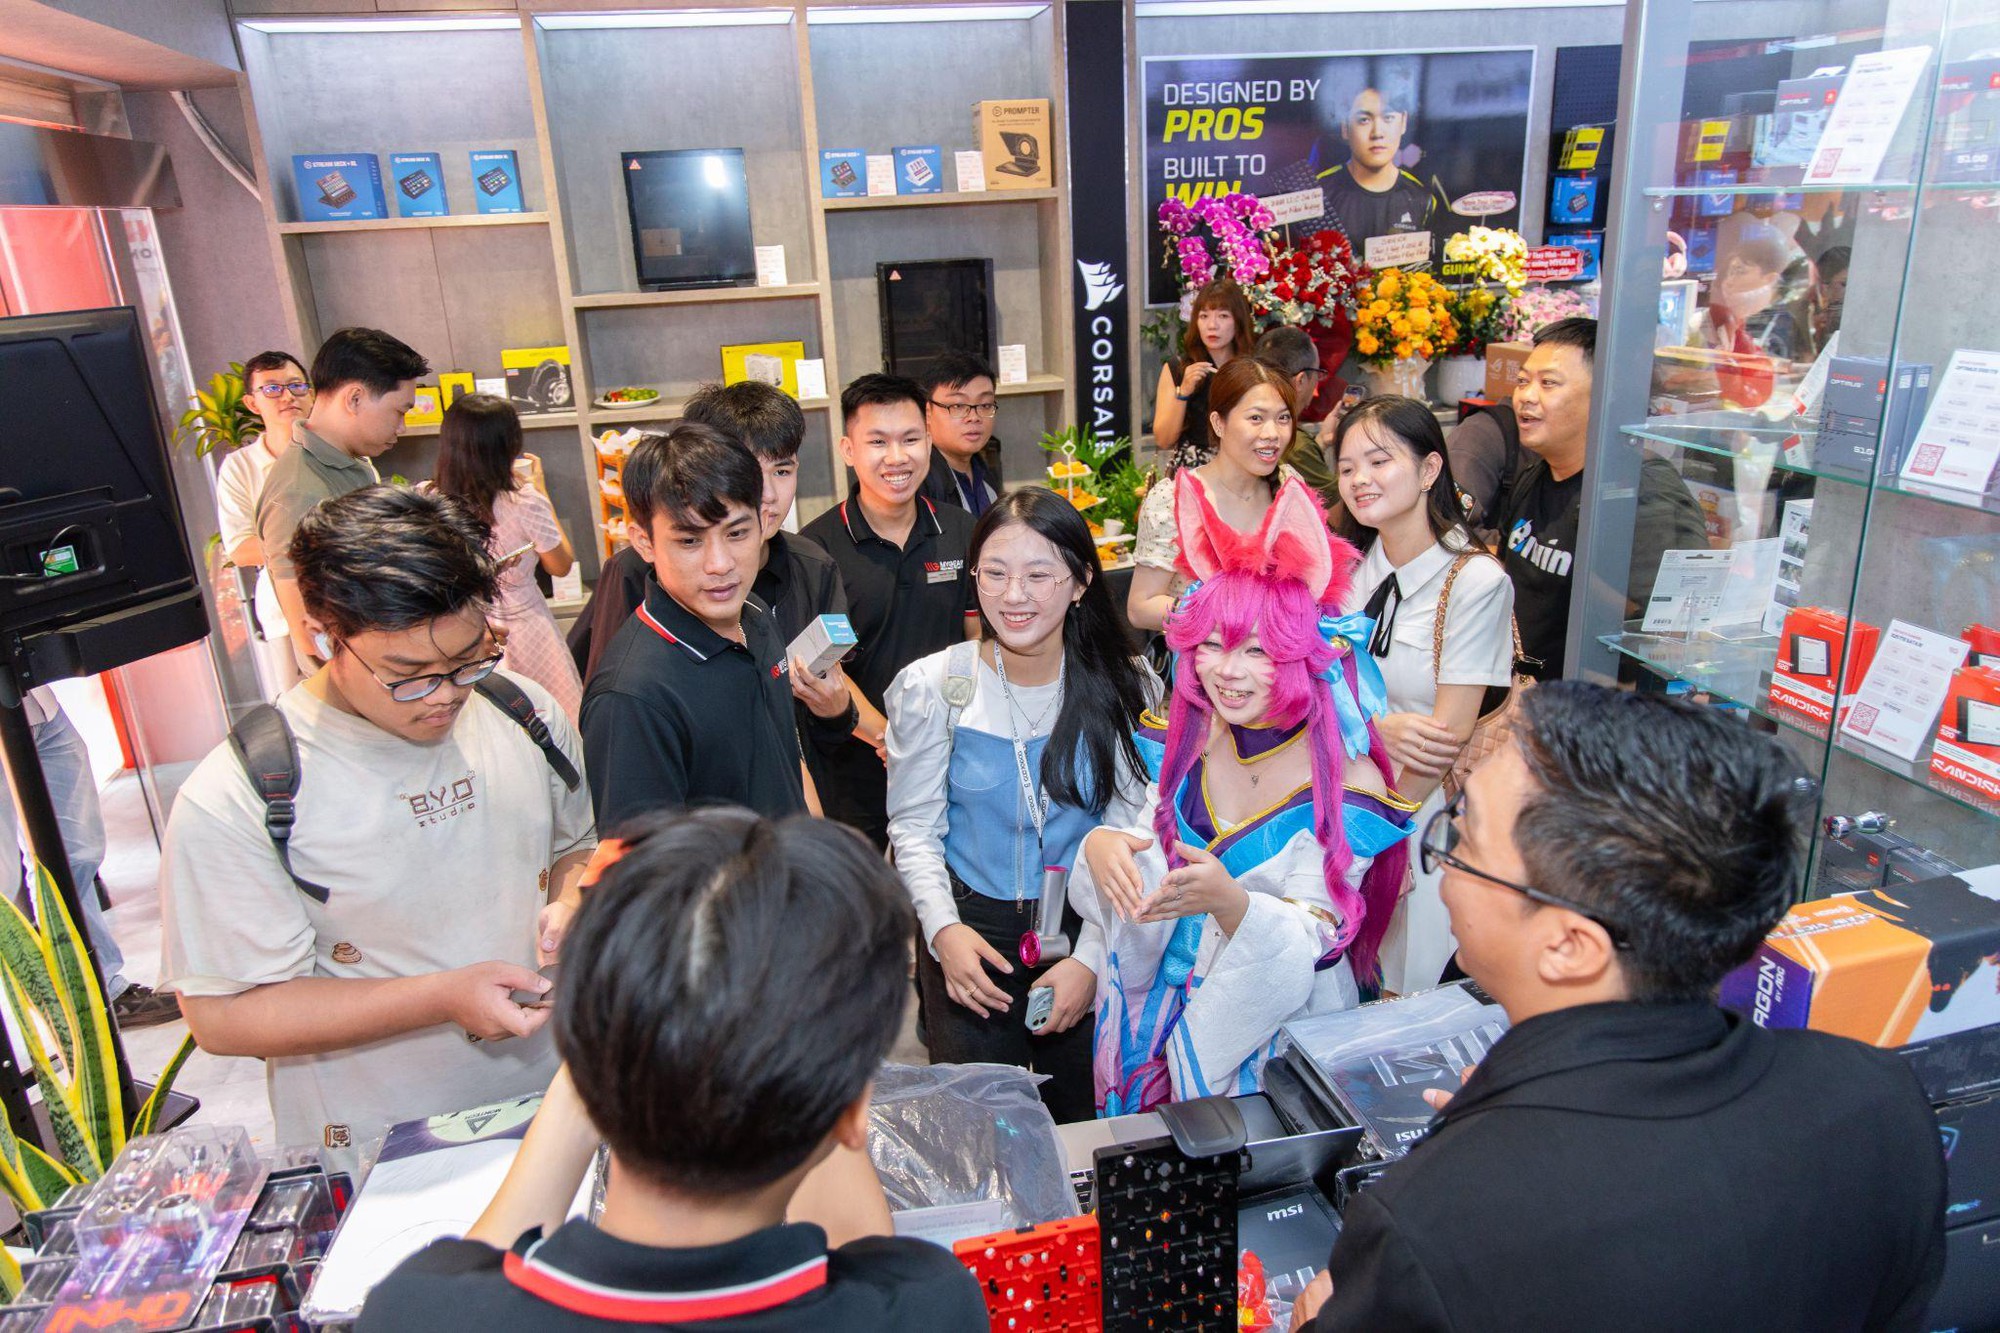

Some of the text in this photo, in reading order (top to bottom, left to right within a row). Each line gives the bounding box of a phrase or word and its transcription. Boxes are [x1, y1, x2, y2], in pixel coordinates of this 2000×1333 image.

[1164, 79, 1321, 106] DESIGNED BY
[1003, 106, 1040, 115] PROMPTER
[1162, 106, 1266, 143] PROS
[1164, 154, 1266, 180] BUILT TO
[1770, 688, 1830, 721] SANDISK
[418, 802, 475, 828] studio
[1752, 955, 1777, 1029] AGON
[1266, 1203, 1304, 1222] msi
